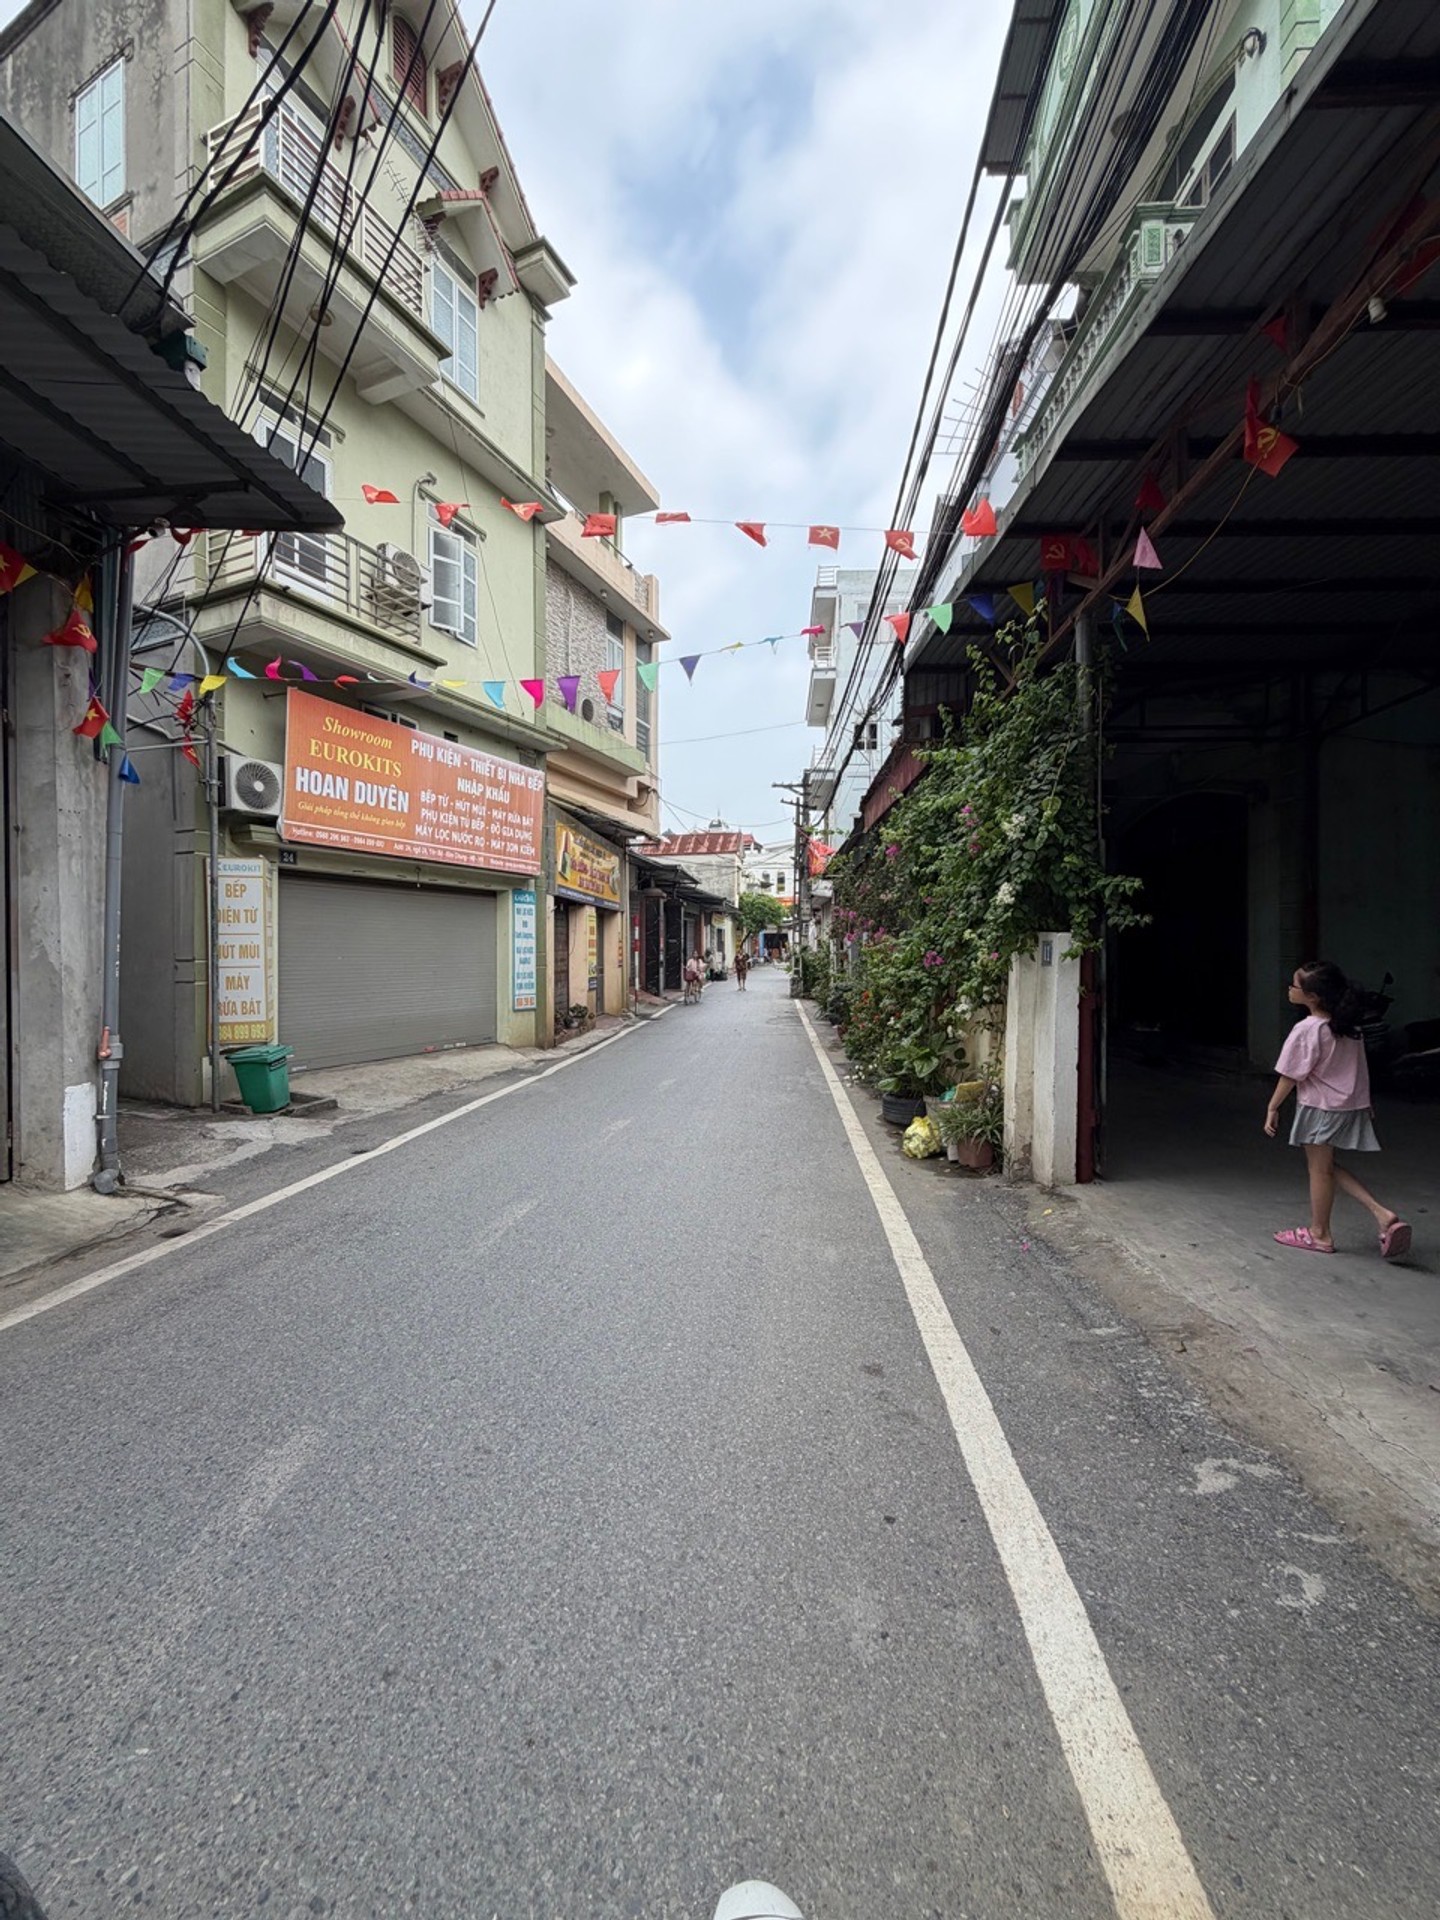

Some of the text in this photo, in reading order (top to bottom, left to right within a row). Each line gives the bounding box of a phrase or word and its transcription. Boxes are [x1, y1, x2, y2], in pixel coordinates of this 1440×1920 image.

[322, 716, 393, 750] Showroom
[309, 738, 402, 778] EUROKITS
[411, 740, 434, 762] PHỤ
[436, 747, 462, 768] KIỆN
[470, 758, 496, 777] THIẾT
[496, 764, 507, 784] BỊ
[508, 769, 526, 786] NHÀ
[527, 770, 543, 792] BẾP
[295, 766, 409, 813] HOAN DUYÊN
[420, 789, 436, 805] BẾP
[457, 777, 484, 798] NHẬP
[283, 852, 294, 862] 24
[225, 879, 247, 898] BẾP
[238, 941, 260, 959] MÙI
[225, 972, 250, 991] MÁY
[240, 997, 262, 1016] BÁT
